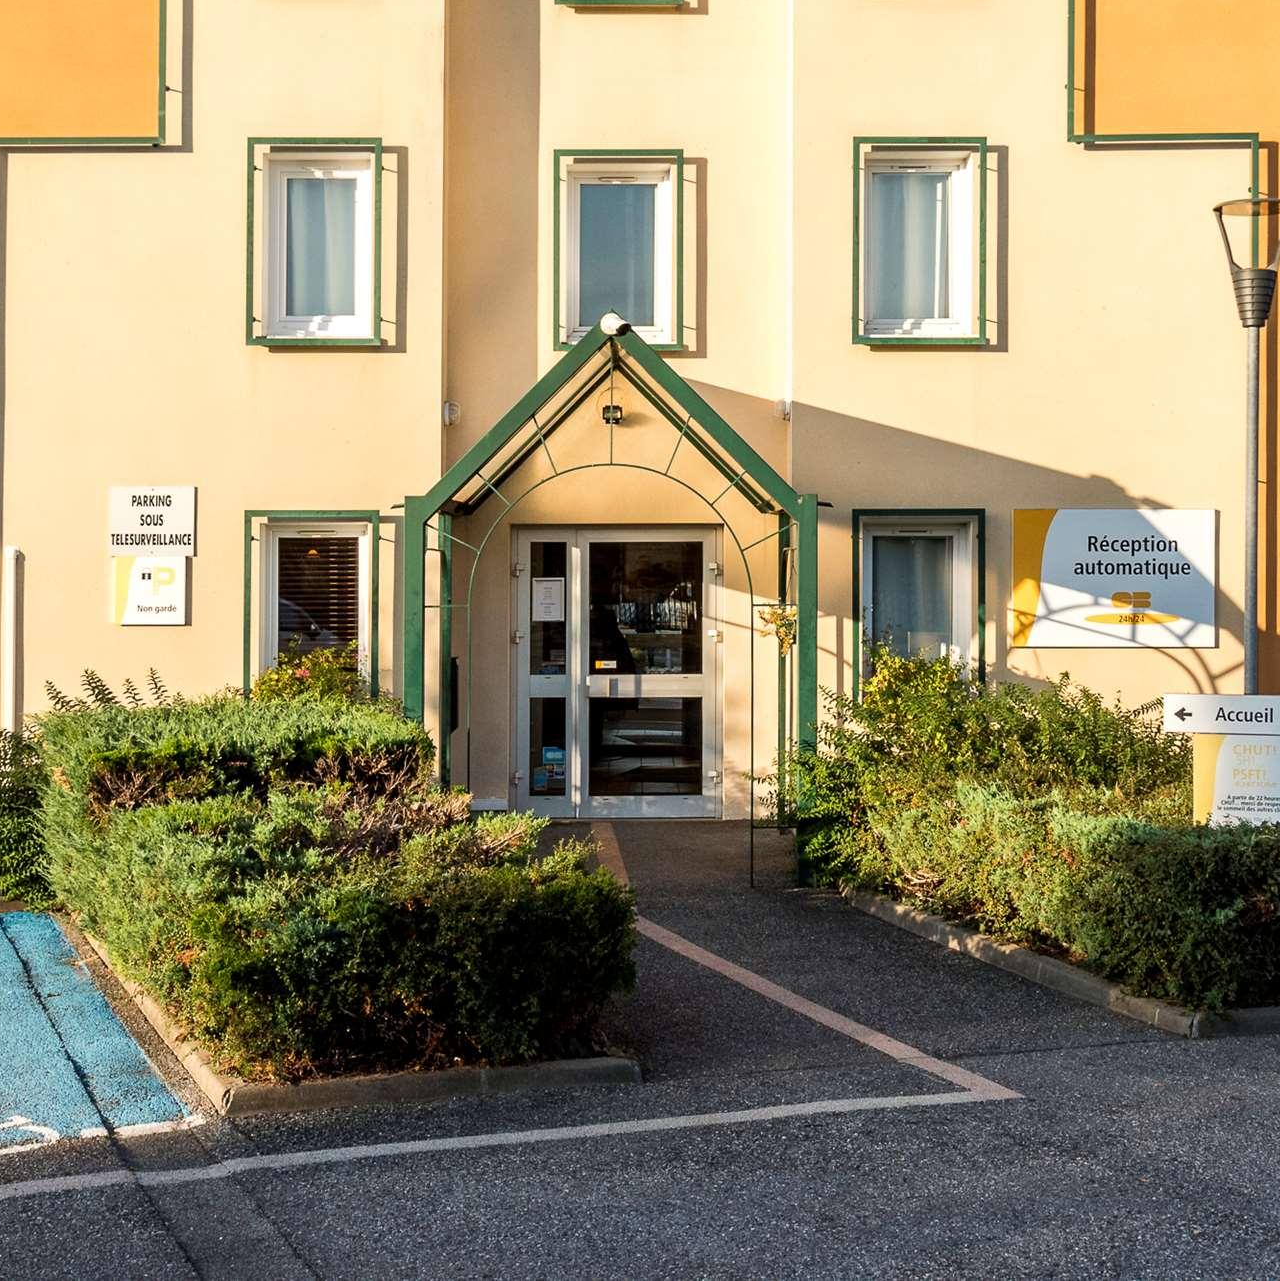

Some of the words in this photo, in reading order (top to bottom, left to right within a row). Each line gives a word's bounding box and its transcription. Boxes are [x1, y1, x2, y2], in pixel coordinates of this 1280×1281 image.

[131, 494, 172, 507] PARKING
[139, 514, 164, 526] SOUS
[110, 533, 192, 546] TELESURVEILLANCE
[1087, 535, 1178, 556] Réception
[1074, 558, 1191, 579] automatique
[154, 604, 177, 614] gardé
[1215, 707, 1274, 723] Accueil
